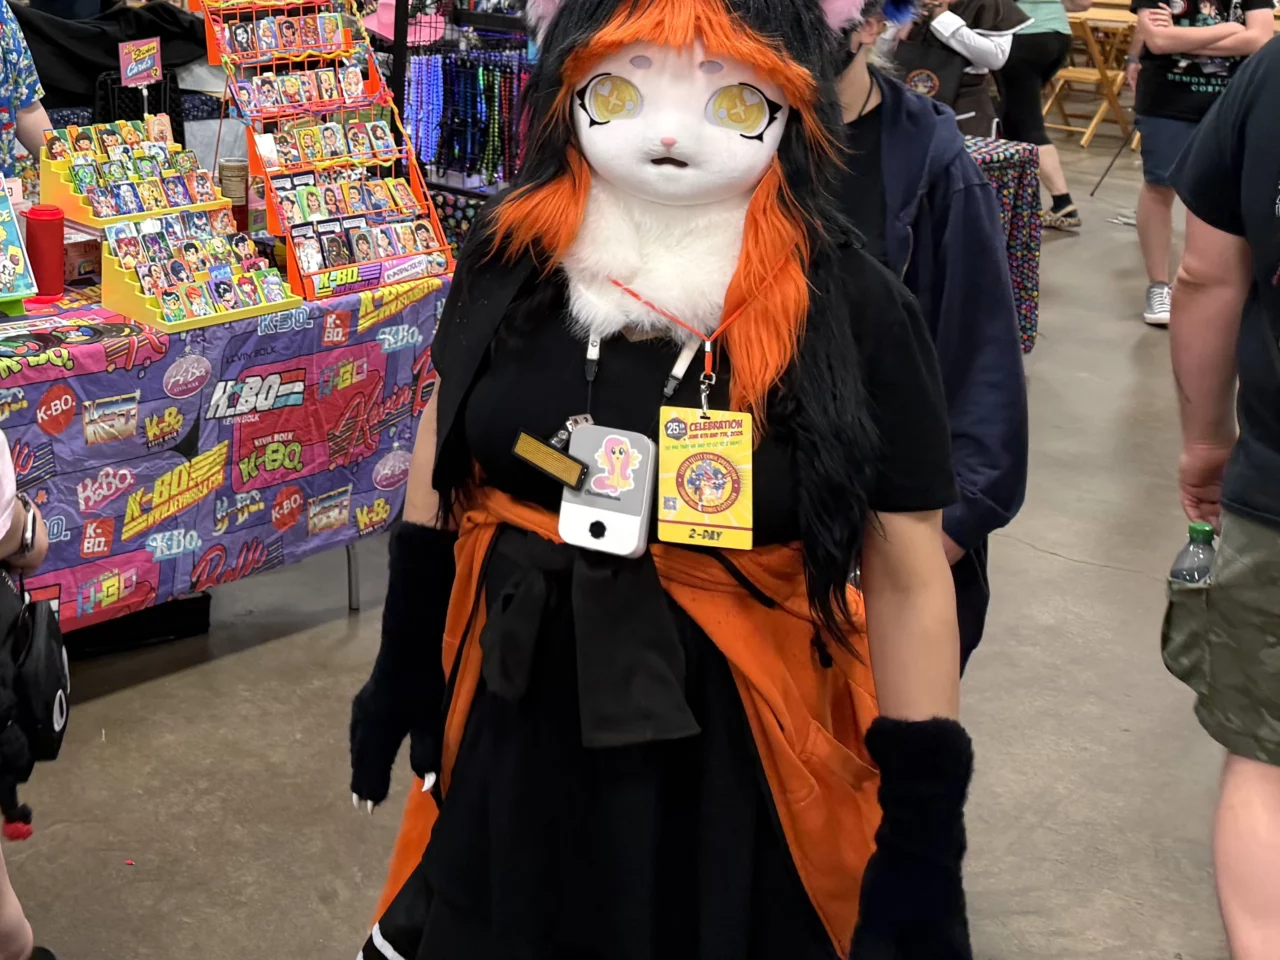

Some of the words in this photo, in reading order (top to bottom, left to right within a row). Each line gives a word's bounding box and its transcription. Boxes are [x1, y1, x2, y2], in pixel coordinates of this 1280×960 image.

[127, 56, 151, 77] Cards
[1168, 73, 1206, 84] DEMON
[319, 267, 363, 289] K-BO.
[226, 351, 252, 365] KEVIN
[255, 345, 277, 357] BOLK
[36, 394, 76, 424] K-BO.
[334, 377, 412, 466] Kevin
[689, 419, 743, 432] CELEBRATION
[254, 436, 272, 447] KEVIN
[274, 431, 295, 441] BOLK
[238, 442, 303, 483] K-BO.
[271, 497, 303, 522] K-BO.
[86, 523, 102, 538] K-
[688, 528, 722, 540] 2-DAY
[83, 537, 108, 553] BO.
